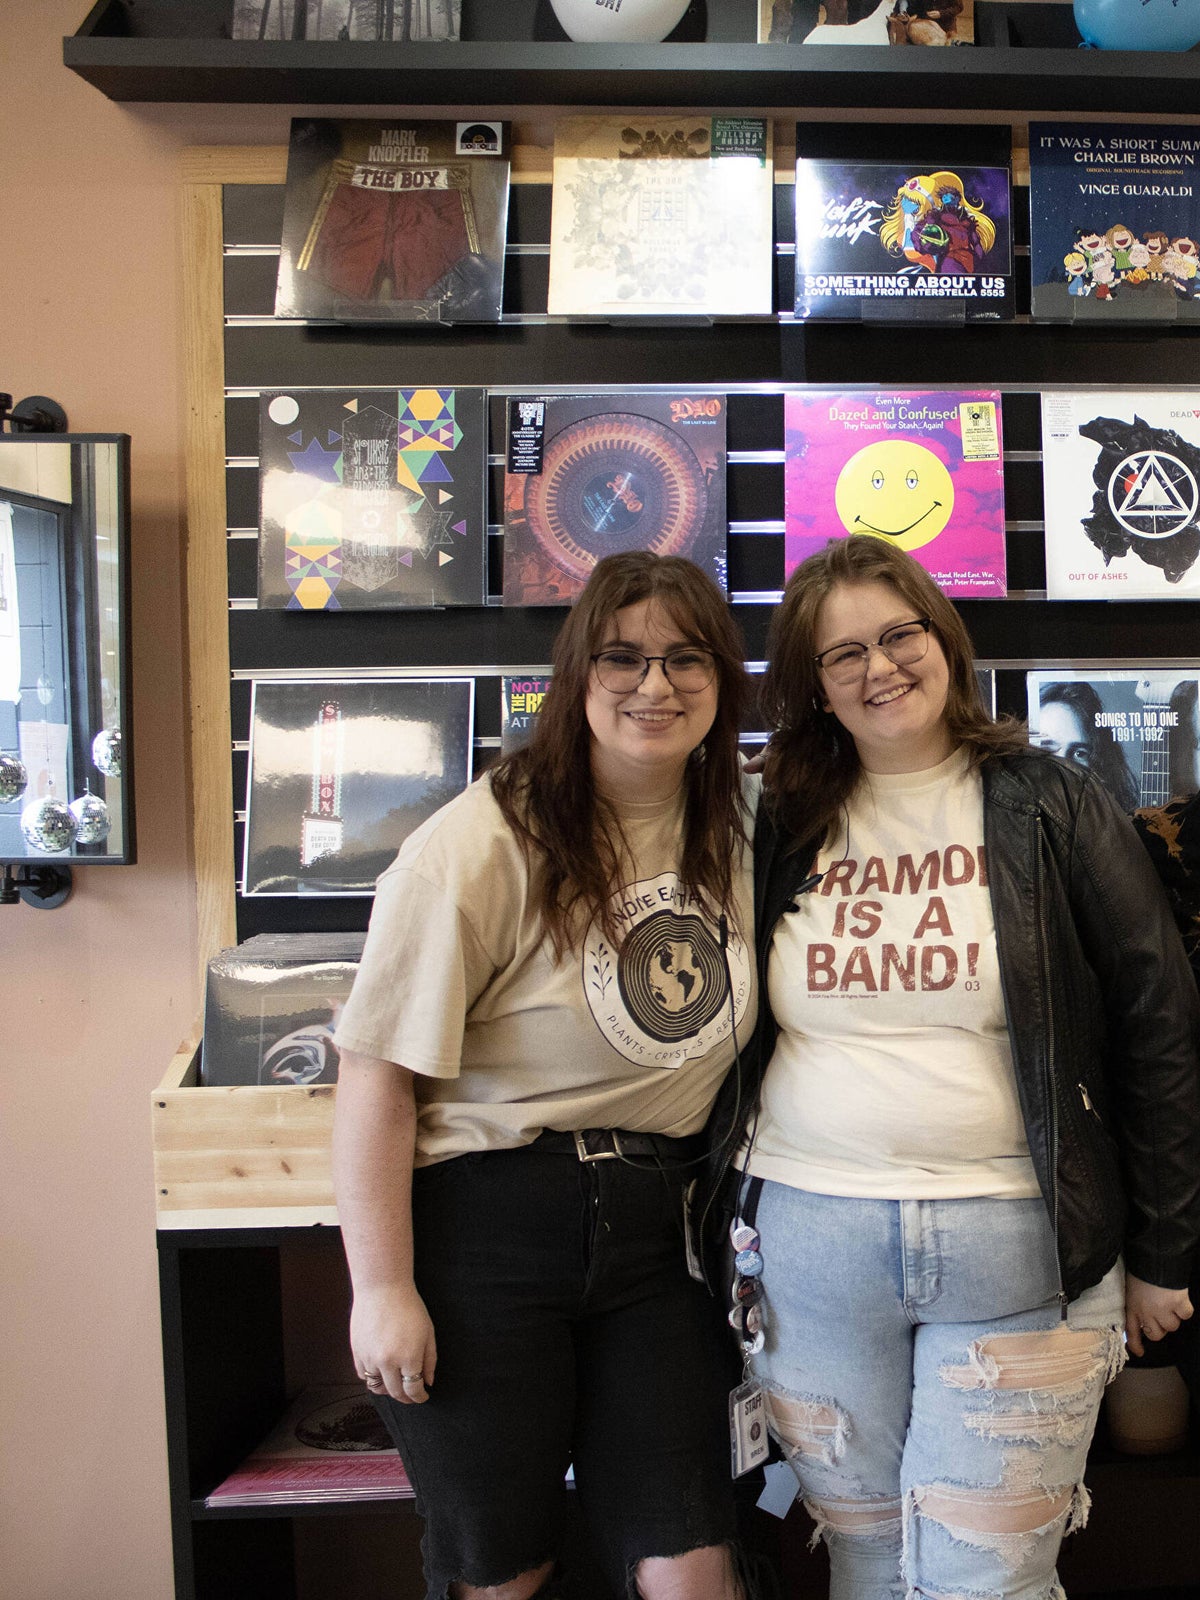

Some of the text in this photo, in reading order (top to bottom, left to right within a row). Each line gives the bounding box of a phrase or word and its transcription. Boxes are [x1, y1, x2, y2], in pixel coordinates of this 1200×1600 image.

[381, 129, 417, 147] MARK
[1040, 137, 1054, 147] IT
[1059, 137, 1092, 148] WAS
[1096, 139, 1106, 149] A
[1110, 139, 1158, 150] SHORT
[368, 145, 429, 163] KNOPFLER
[1074, 152, 1195, 165] CHARLIE BROWN
[361, 169, 440, 188] THE BOY
[1079, 184, 1193, 197] VINCE GUARALDI
[804, 276, 1005, 289] SOMETHING ABOUT US
[804, 288, 1005, 297] LOVE THEME FROM INTERSTELLA 5555
[875, 396, 910, 405] Even More
[829, 407, 868, 420] Dazed
[871, 408, 895, 420] and
[898, 406, 958, 420] Confused
[843, 421, 859, 431] They
[861, 421, 881, 430] Found
[883, 421, 898, 430] Your
[1068, 573, 1085, 581] OUT
[511, 682, 541, 693] NOT
[511, 693, 525, 713] THE
[511, 717, 530, 728] AT
[1095, 711, 1179, 727] SONGS TO NO ONE
[1111, 726, 1164, 742] 1991-1992
[832, 896, 954, 939] IS A
[807, 943, 980, 992] BAND!
[965, 981, 980, 991] 03
[606, 980, 746, 1055] PLANTS RECORDS
[745, 1393, 761, 1415] STAFF
